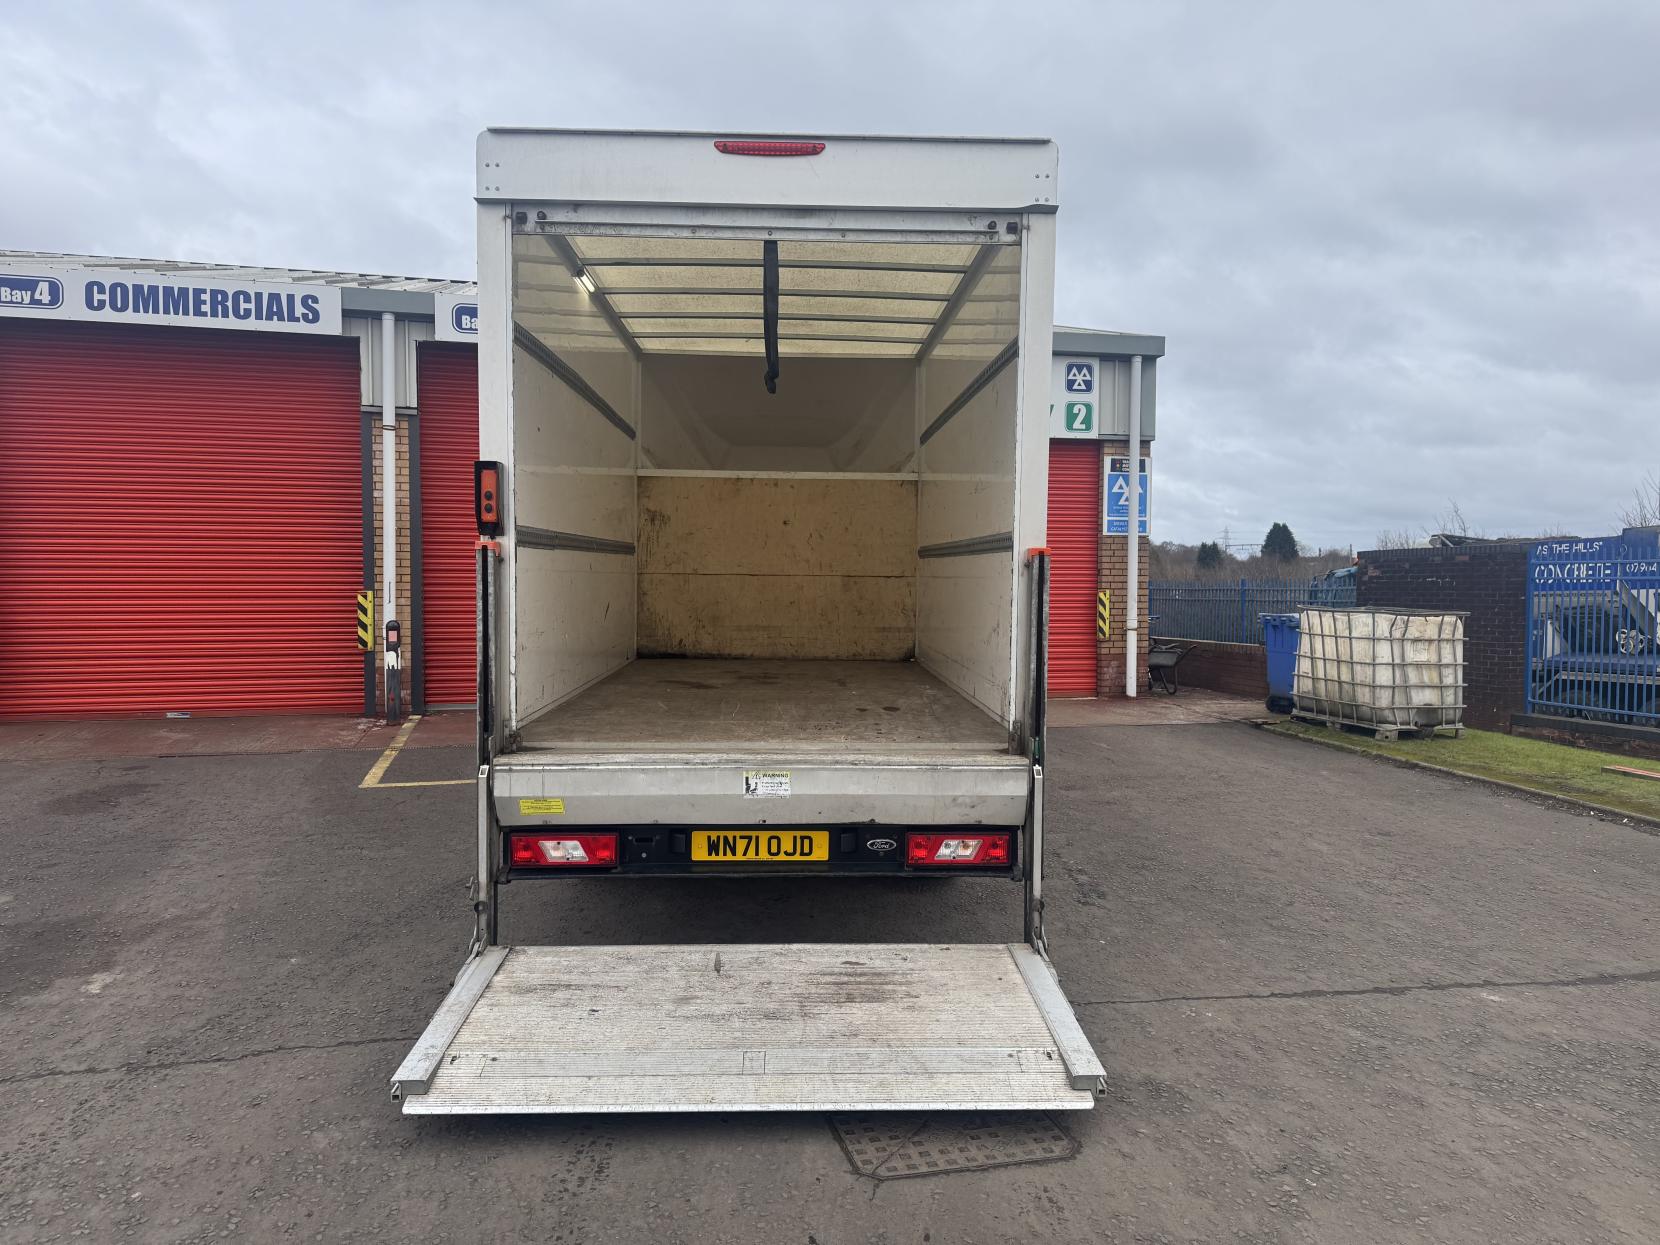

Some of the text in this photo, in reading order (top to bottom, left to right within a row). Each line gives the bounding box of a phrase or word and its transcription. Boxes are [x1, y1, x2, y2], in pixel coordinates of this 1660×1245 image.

[0, 281, 51, 304] Bay 4
[84, 280, 320, 324] COMMERCIALS
[1072, 404, 1086, 429] 2
[1536, 545, 1548, 555] AS
[1552, 543, 1569, 554] THE
[1534, 563, 1612, 584] CONCRETE
[707, 835, 813, 857] WN71 OJD
